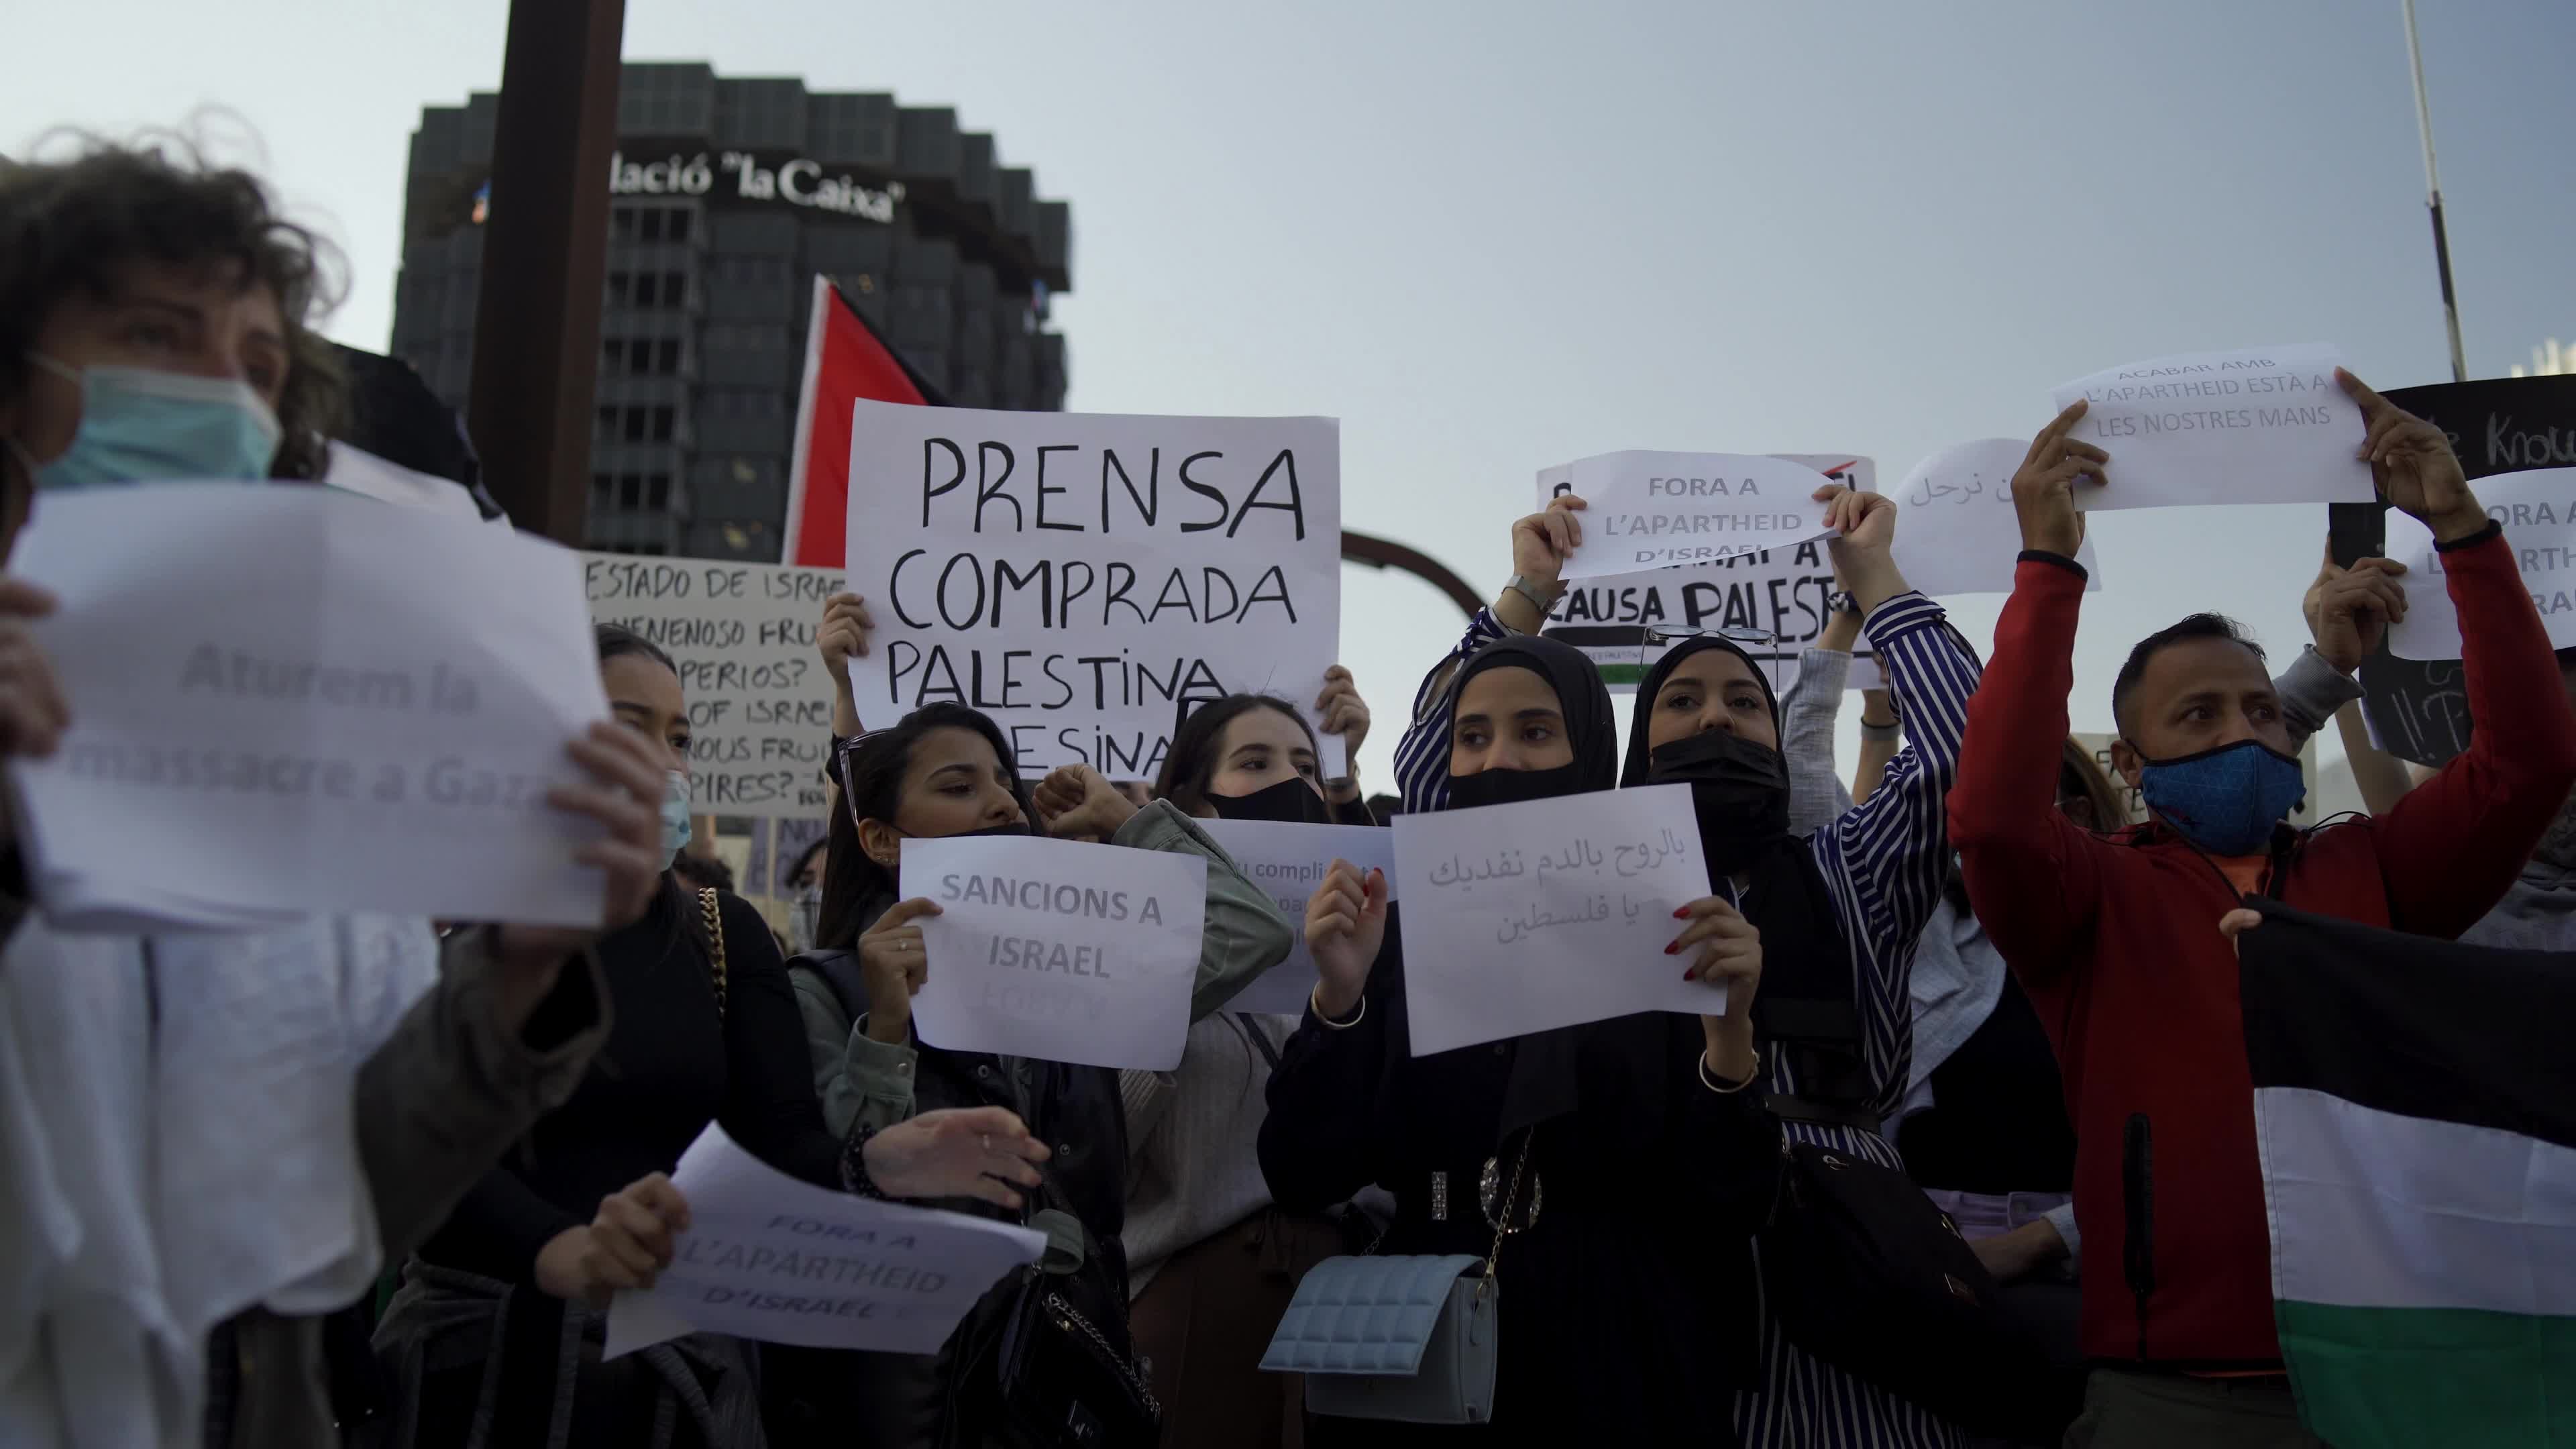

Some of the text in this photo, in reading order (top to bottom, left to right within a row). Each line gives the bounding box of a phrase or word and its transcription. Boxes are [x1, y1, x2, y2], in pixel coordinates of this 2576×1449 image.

[2118, 358, 2276, 380] ACABAR AMB
[2085, 372, 2328, 402] L'APARTHEID ESTÀ A
[2096, 406, 2331, 437] LES NOSTRES MANS
[923, 437, 1305, 541] PRENSA
[1648, 477, 1760, 496] FORA A
[1911, 472, 1983, 506] نرحل
[1605, 513, 1803, 537] L'APARTHEID
[2486, 502, 2557, 527] ORA
[585, 559, 690, 602] ESTADO
[705, 569, 748, 599] DE
[889, 549, 1297, 631] COMPRADA
[759, 618, 816, 647] FRU
[178, 641, 482, 713] Aturem la
[680, 659, 808, 692] PERIOS?
[689, 700, 731, 727] OF
[686, 736, 751, 763] NOUS
[371, 763, 407, 804] a
[689, 771, 794, 804] PIRES?
[1429, 826, 1685, 892] بالروح بالدم نفديك
[941, 874, 1163, 926] SANCIONS A
[1497, 893, 1640, 945] يا فلسطين
[989, 934, 1111, 979] ISRAEL
[767, 1215, 918, 1249] FORA A
[682, 1238, 949, 1293] L'APARTHEID
